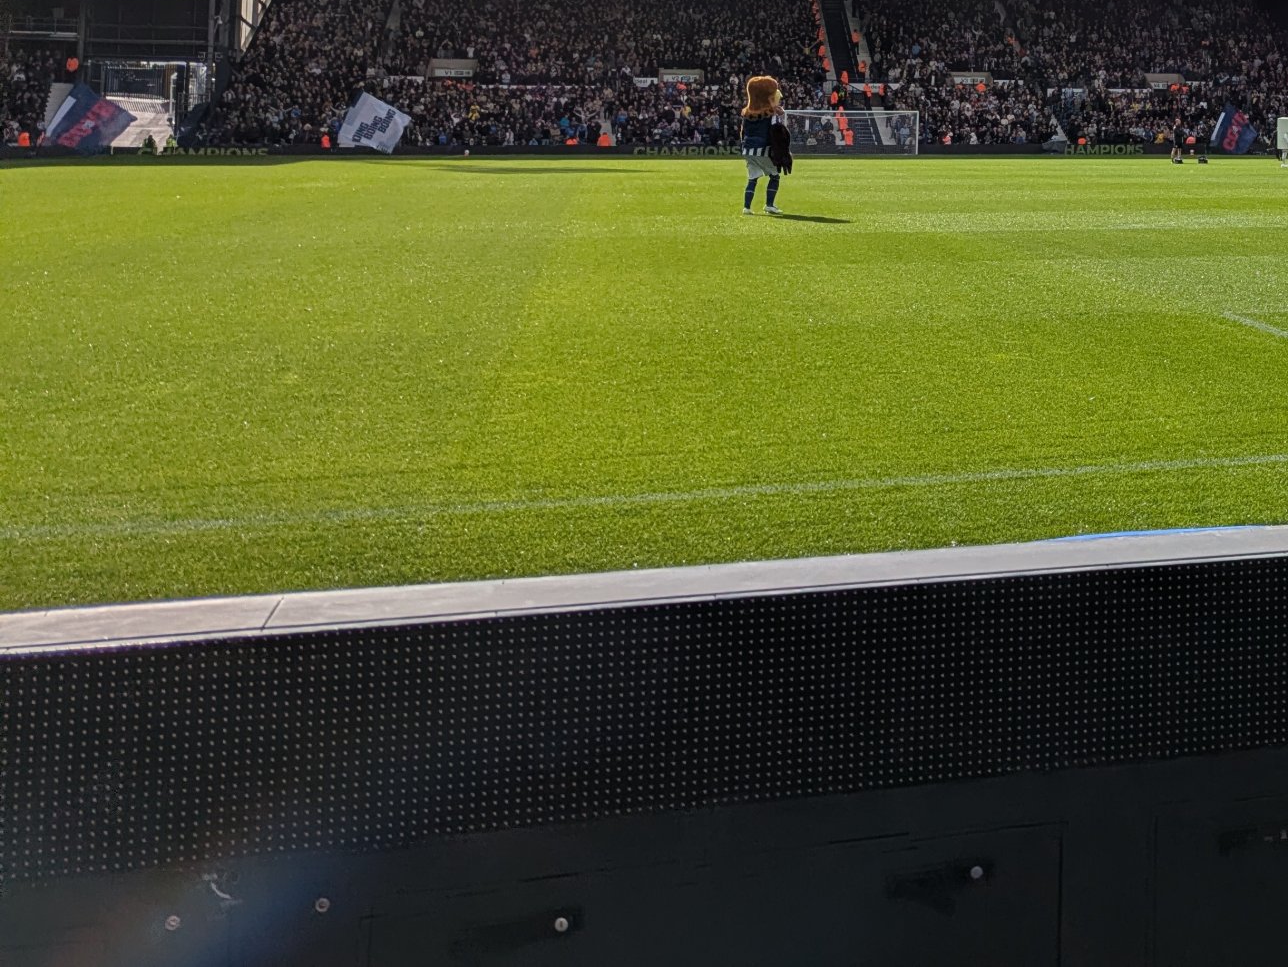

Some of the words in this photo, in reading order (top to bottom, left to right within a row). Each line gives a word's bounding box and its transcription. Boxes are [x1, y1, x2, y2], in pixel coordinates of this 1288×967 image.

[363, 115, 383, 140] BOING
[377, 108, 396, 134] BOING
[633, 146, 742, 156] CHAMPIONS
[1064, 144, 1144, 156] HAMPIONS
